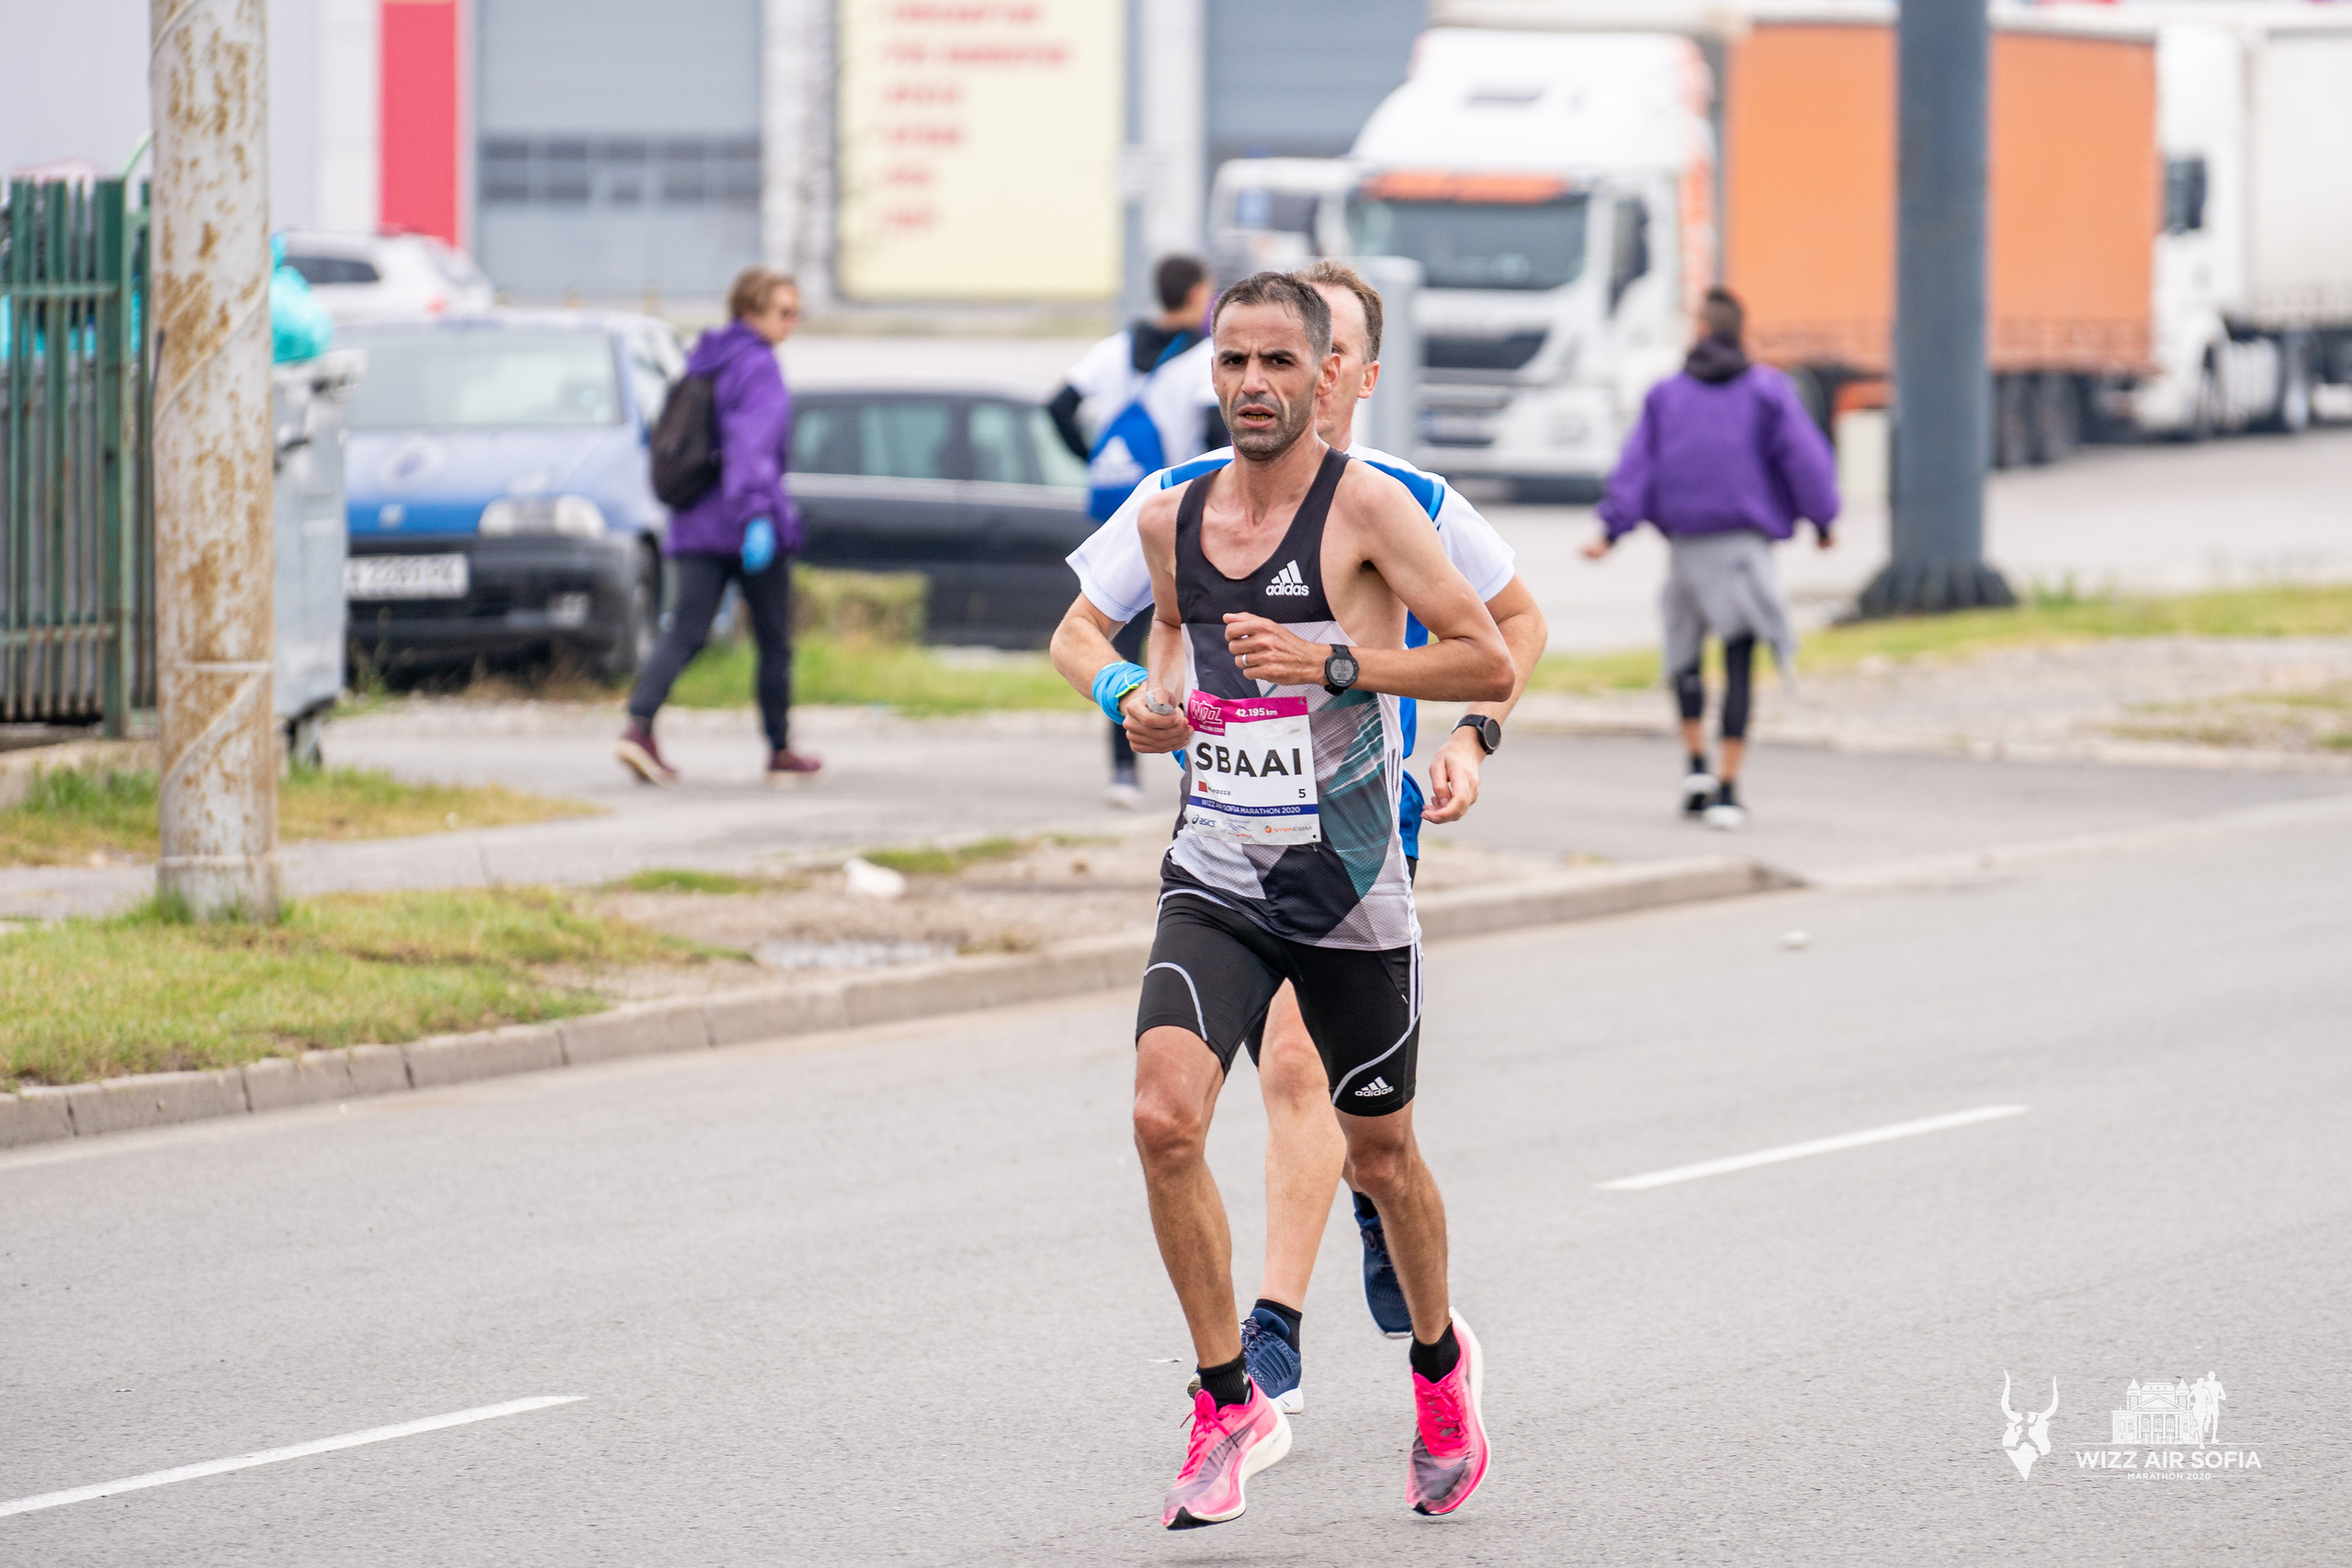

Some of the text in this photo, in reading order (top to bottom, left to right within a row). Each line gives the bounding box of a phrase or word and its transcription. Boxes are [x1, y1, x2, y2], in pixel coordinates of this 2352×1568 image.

[1265, 581, 1310, 596] adidas
[1235, 707, 1265, 717] 42.195
[1195, 741, 1302, 777] SBAAI
[1298, 788, 1306, 798] 5
[1201, 798, 1216, 807] WIZZ
[1223, 804, 1239, 813] SOFIA
[1240, 807, 1281, 815] MARATHON
[1282, 806, 1301, 814] 2020
[1354, 1086, 1394, 1097] adidas
